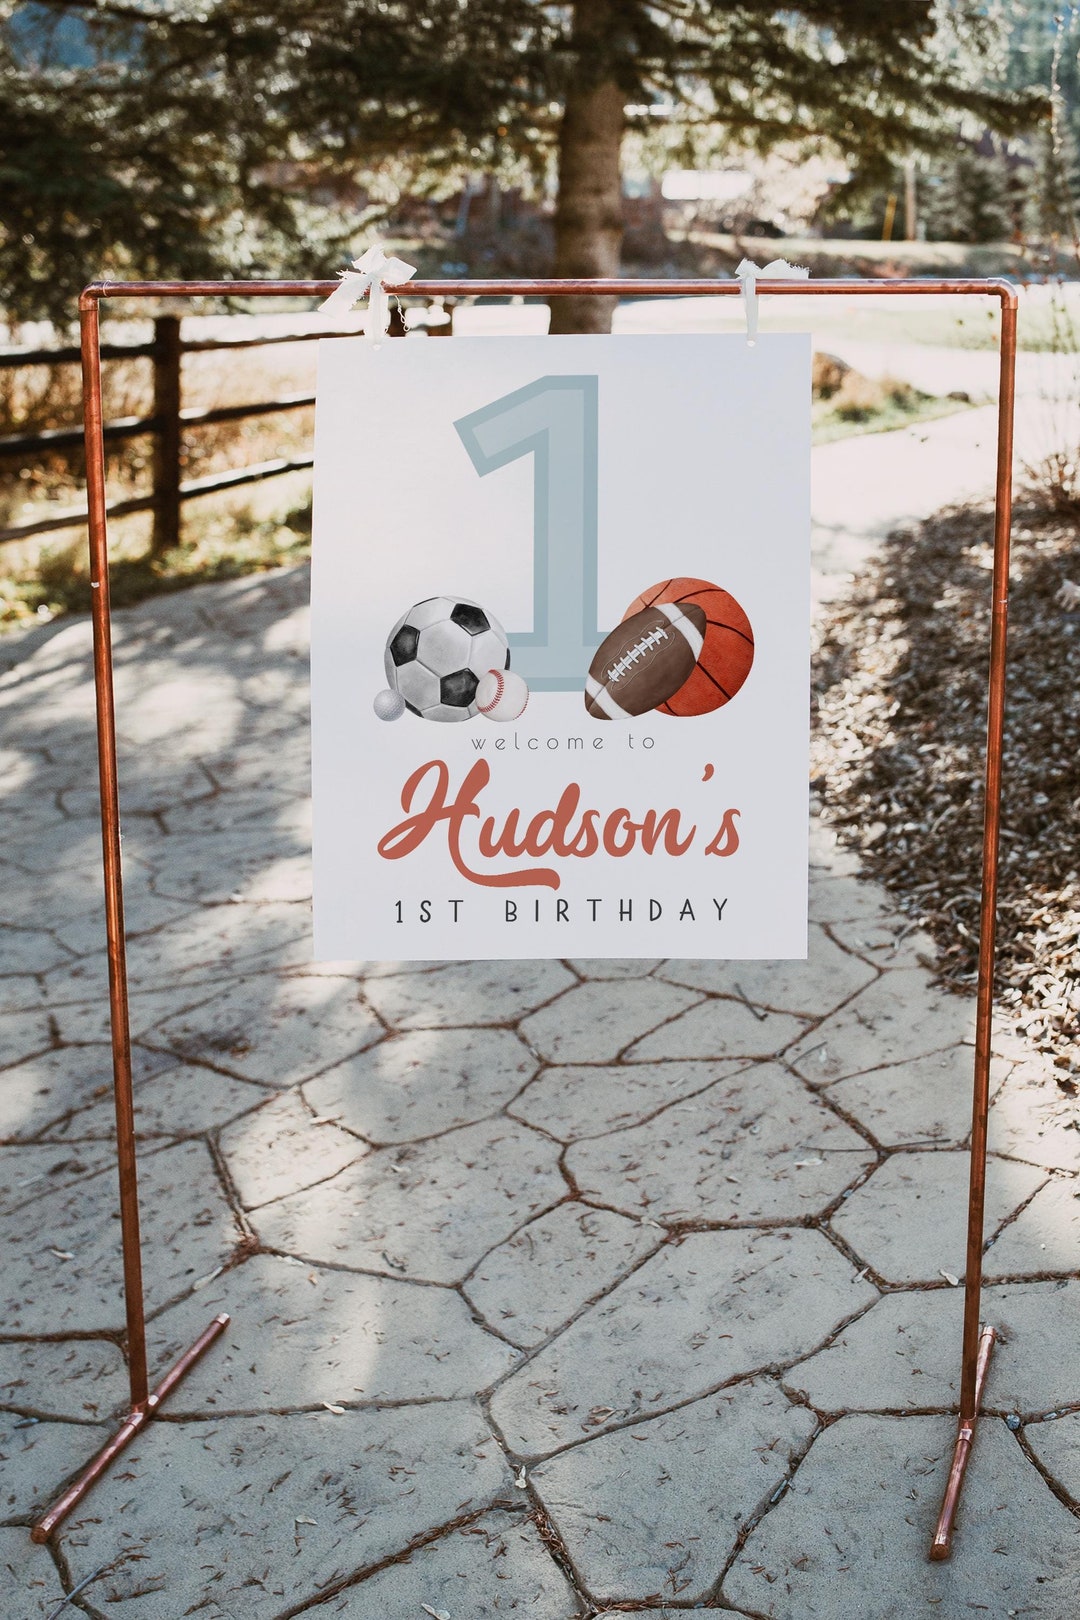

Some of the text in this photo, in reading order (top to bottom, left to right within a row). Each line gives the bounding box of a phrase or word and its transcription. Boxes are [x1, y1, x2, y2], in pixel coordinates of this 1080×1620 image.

[453, 374, 611, 693] 1
[471, 732, 656, 751] welcome to
[377, 758, 741, 890] Hudson's
[394, 897, 730, 924] 1ST BIRTHDAY
